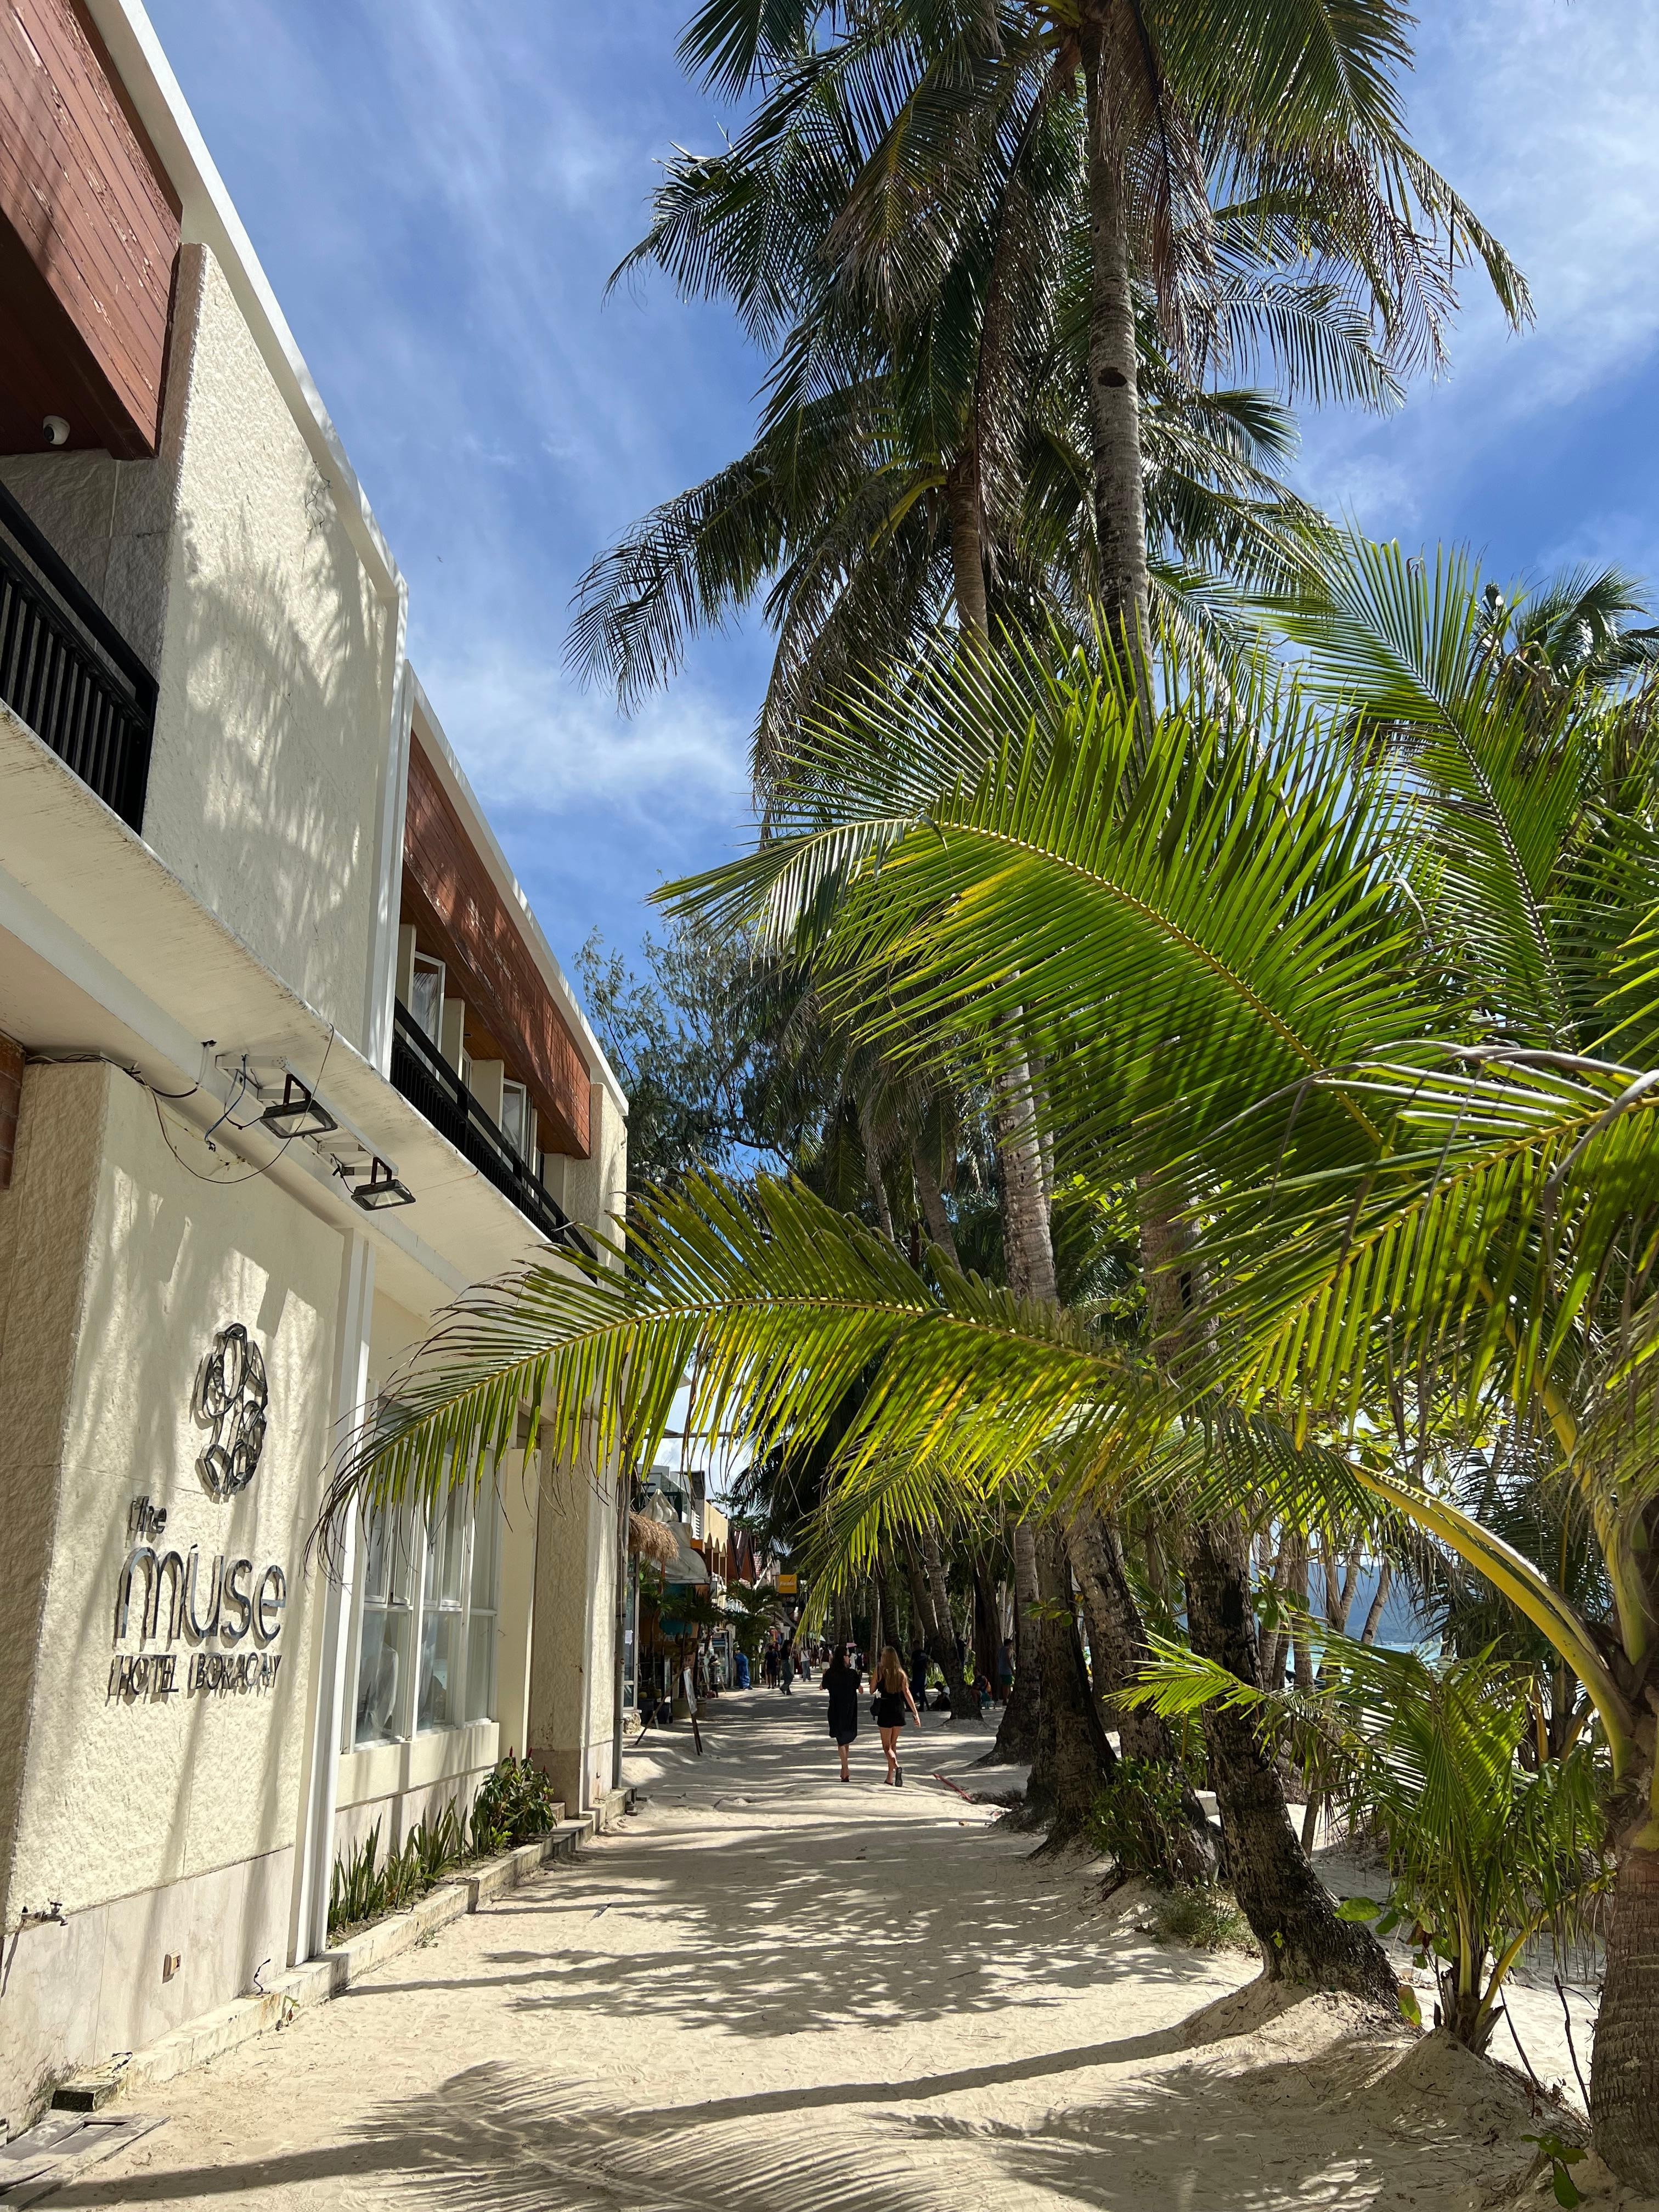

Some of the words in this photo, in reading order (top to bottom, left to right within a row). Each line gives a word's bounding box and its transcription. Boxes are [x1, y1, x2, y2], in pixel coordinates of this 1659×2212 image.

[129, 1496, 167, 1534] the
[109, 1654, 179, 1696] HOTEL
[188, 1651, 282, 1690] BORACAY
